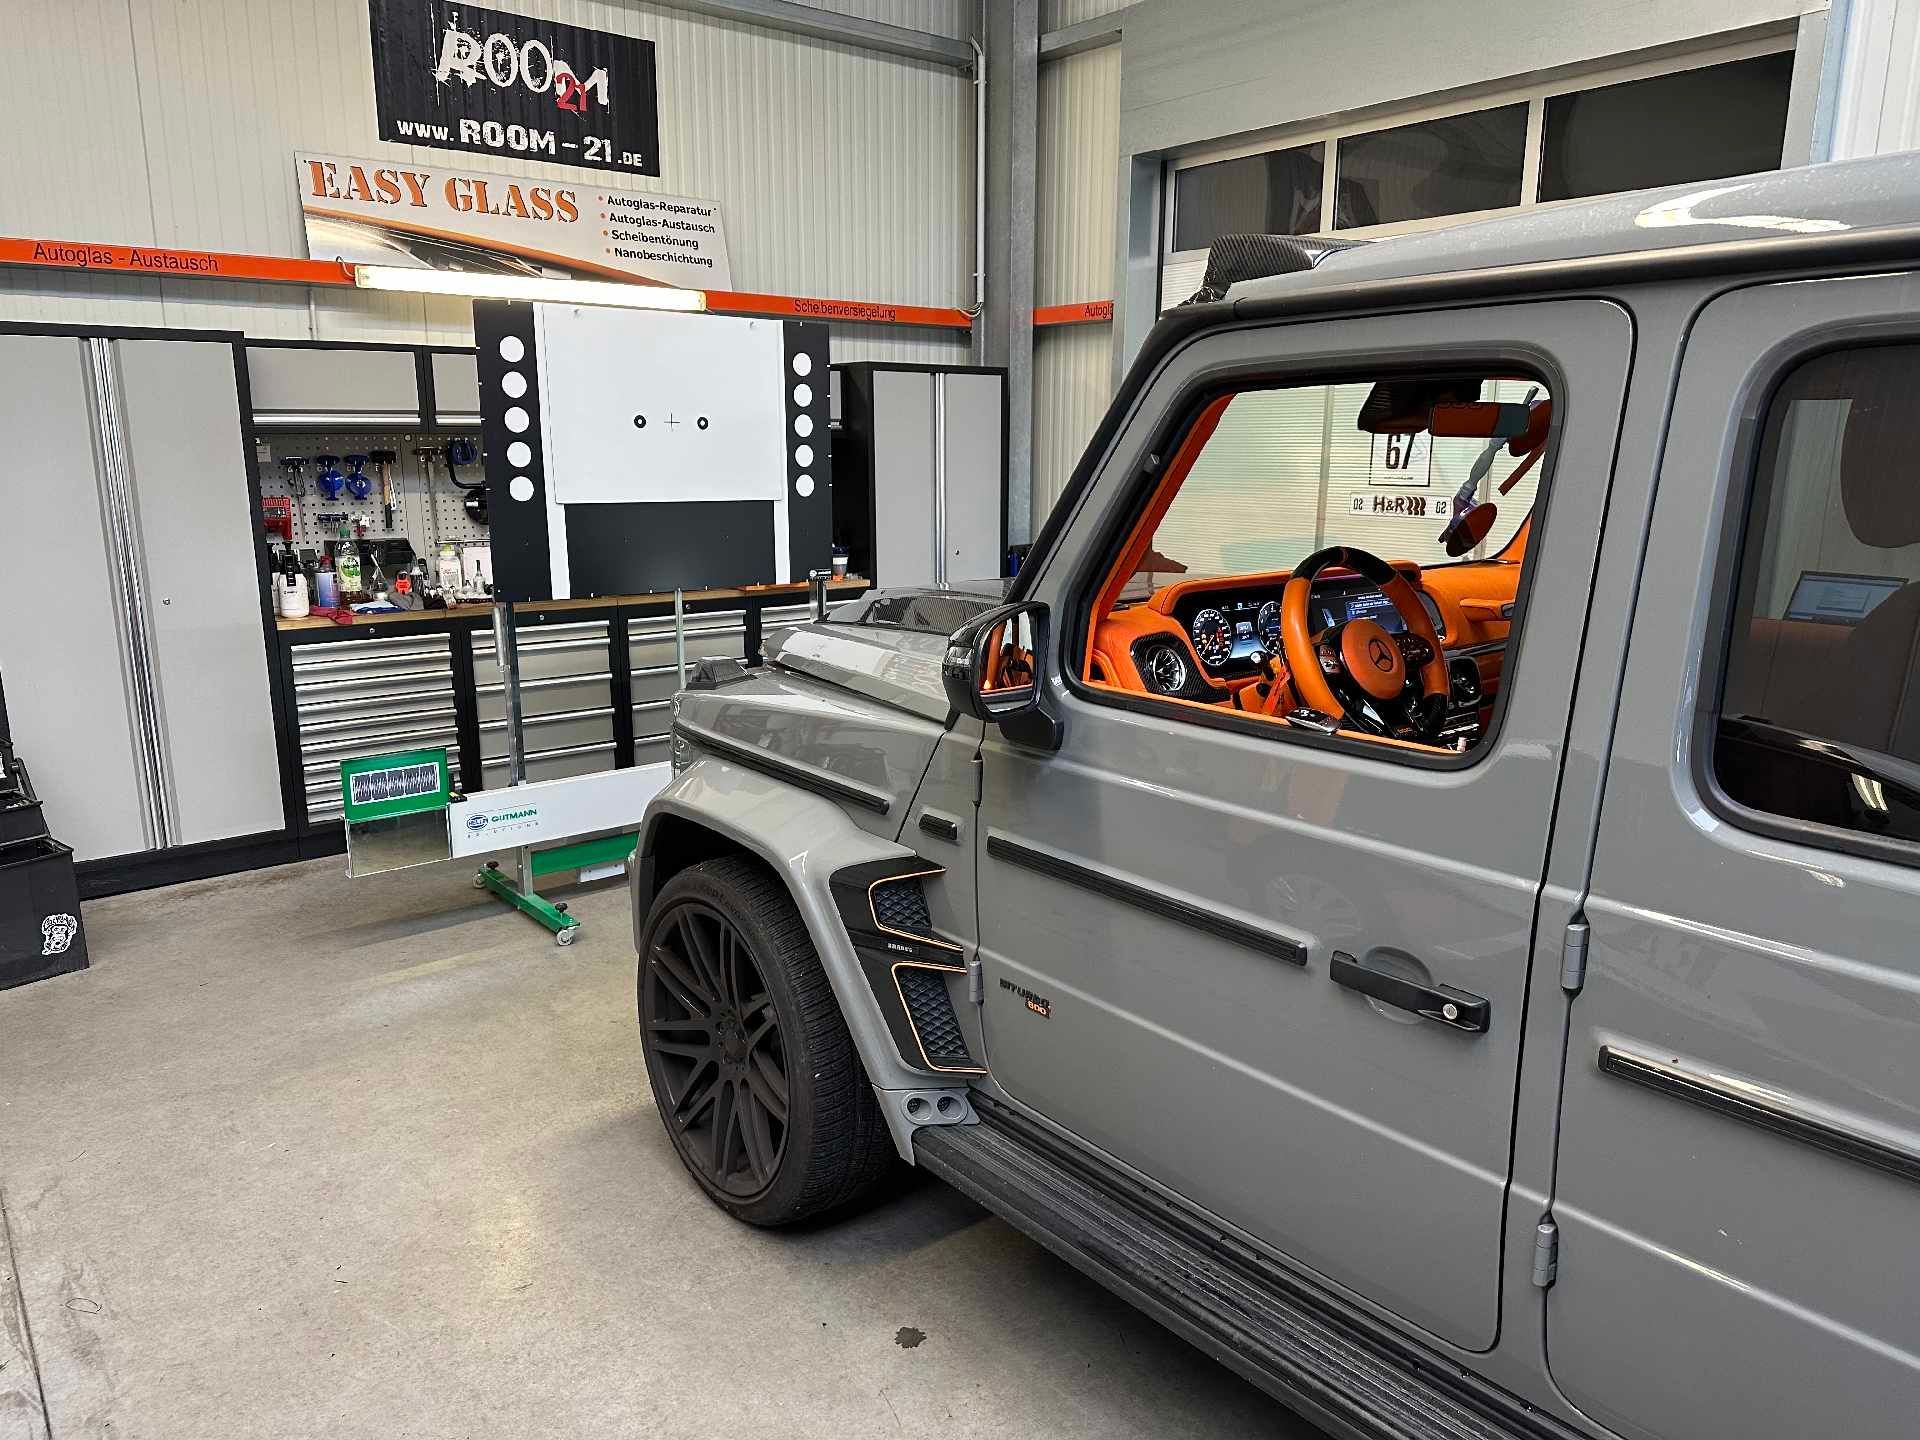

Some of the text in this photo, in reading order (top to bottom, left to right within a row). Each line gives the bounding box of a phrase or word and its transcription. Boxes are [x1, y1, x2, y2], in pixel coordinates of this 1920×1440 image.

[435, 22, 610, 107] ROOM
[555, 72, 587, 112] 21
[308, 160, 579, 223] EASY GLASS
[607, 195, 711, 217] Autoglas-Reparatur
[609, 212, 715, 234] Autoglas-Austausch
[611, 229, 699, 250] Scheibentönung
[33, 242, 114, 267] Autoglas
[129, 249, 220, 272] Austausch
[614, 247, 713, 268] Nanobeschichtung
[794, 299, 896, 322] Scheibenversiegelung
[1385, 433, 1416, 470] 67
[1373, 495, 1405, 514] H&R
[491, 809, 537, 822] GUTMANN
